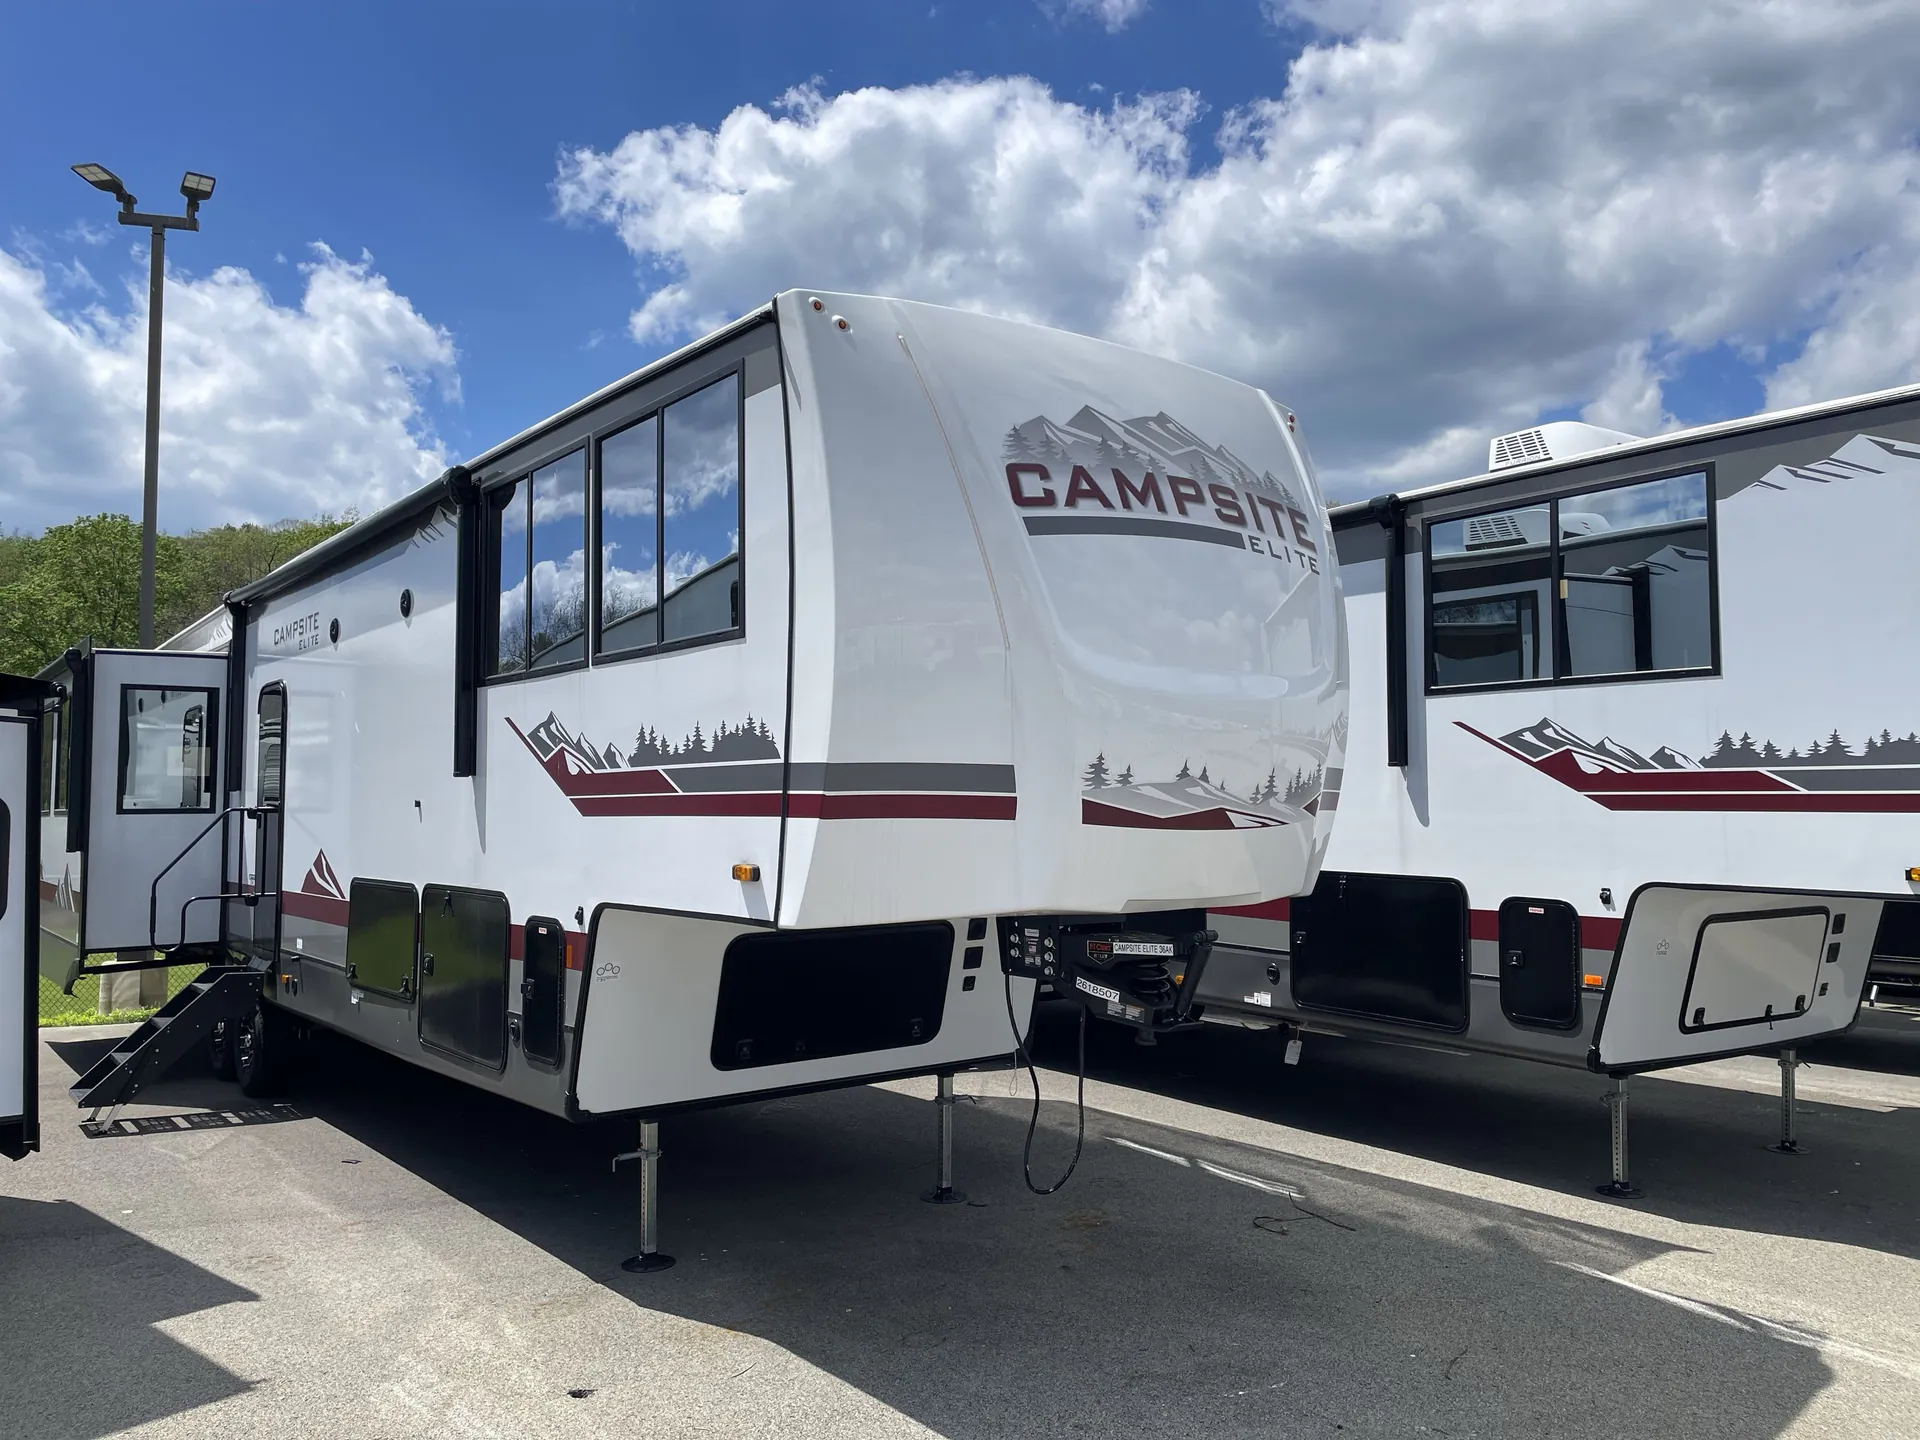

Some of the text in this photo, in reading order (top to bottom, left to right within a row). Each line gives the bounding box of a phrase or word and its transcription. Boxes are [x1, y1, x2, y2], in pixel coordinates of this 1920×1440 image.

[1504, 455, 1541, 466] FURRION
[1005, 462, 1318, 553] CAMPSITE
[1247, 535, 1320, 576] ELITE
[273, 611, 320, 645] CAMPSITE
[298, 634, 319, 650] ELITE
[1114, 943, 1142, 953] CAMPSITE
[1142, 944, 1158, 954] ELITE
[1076, 978, 1119, 1000] 2618507
